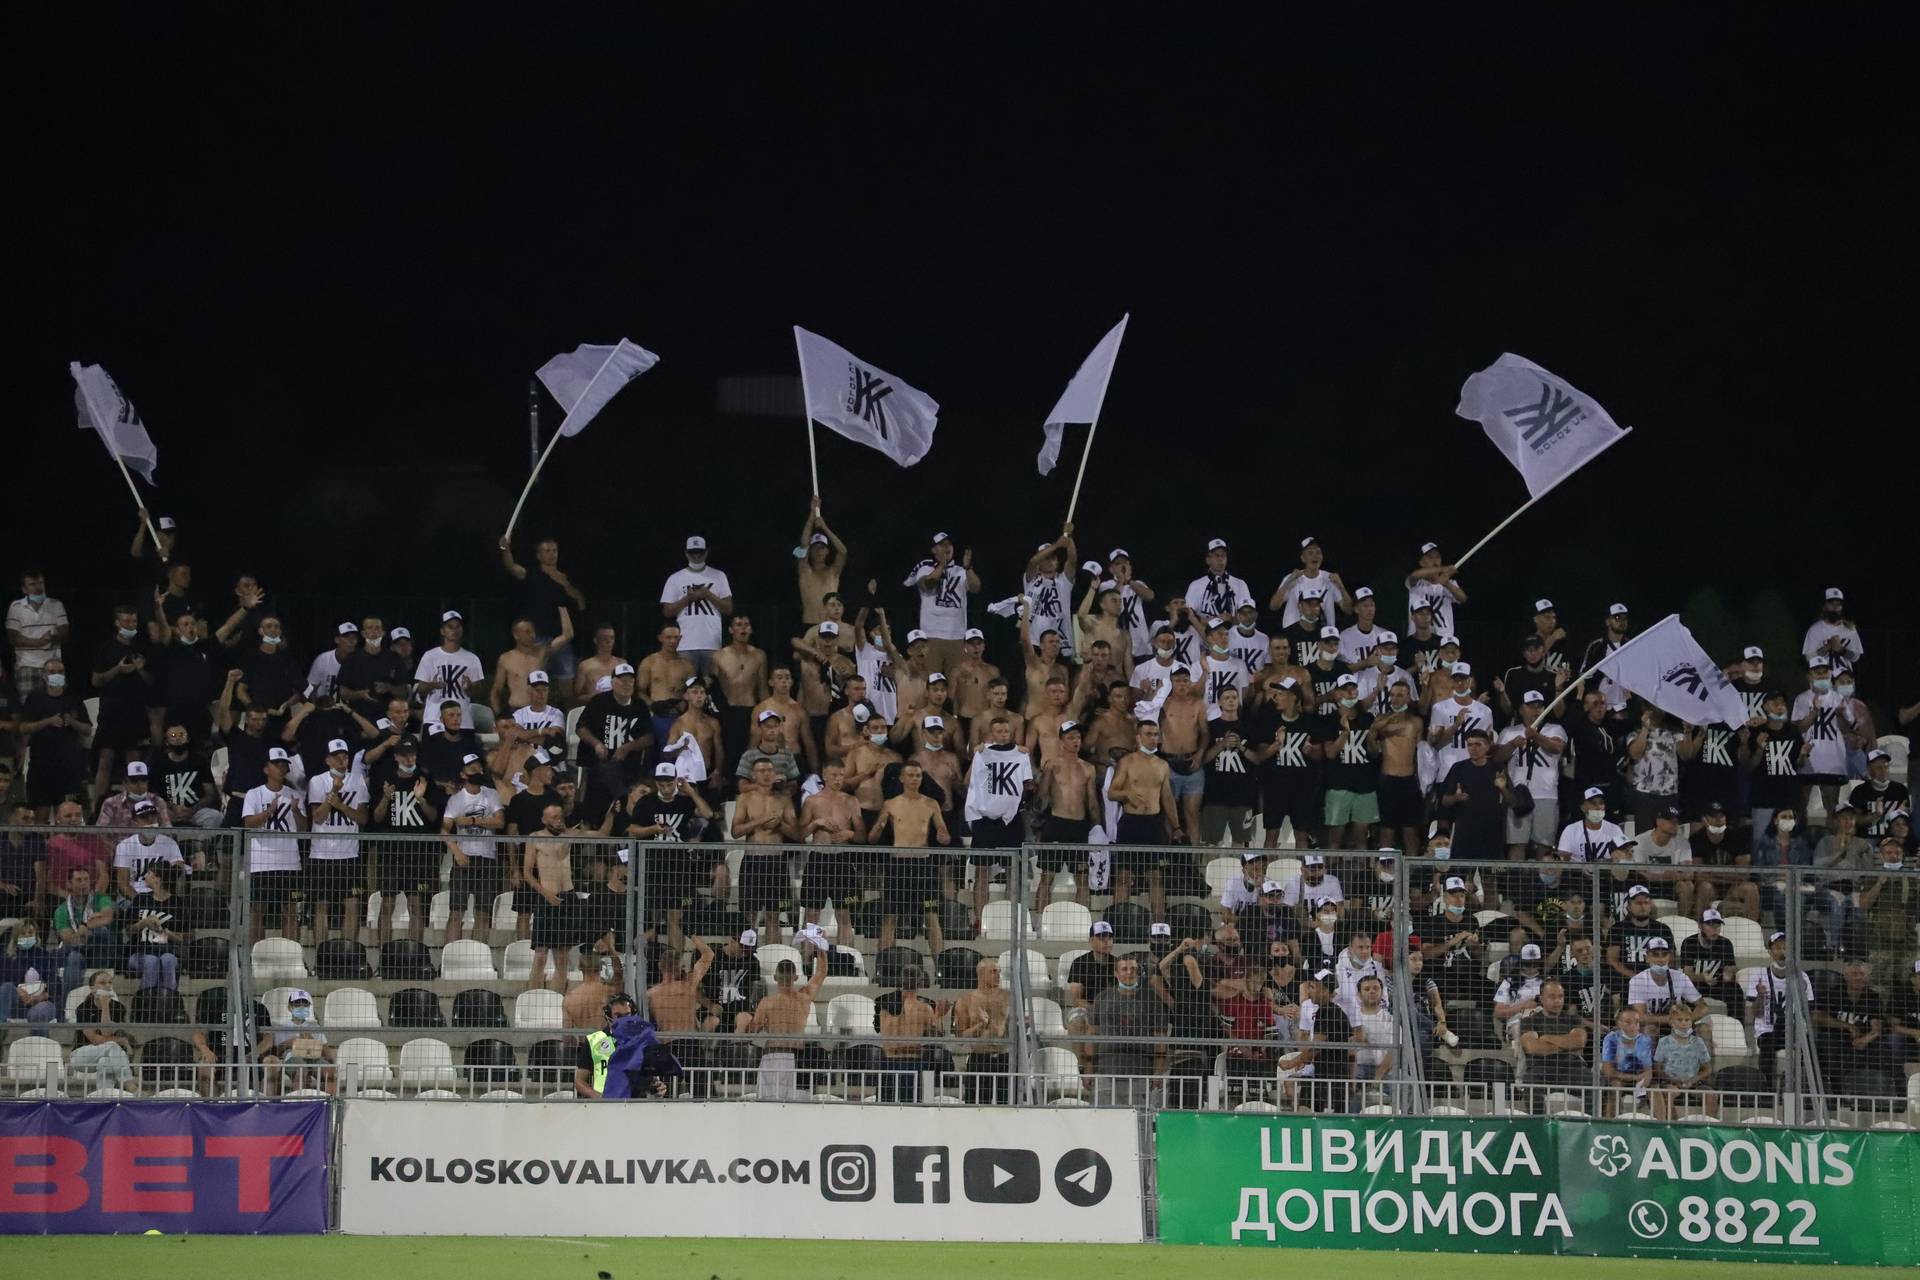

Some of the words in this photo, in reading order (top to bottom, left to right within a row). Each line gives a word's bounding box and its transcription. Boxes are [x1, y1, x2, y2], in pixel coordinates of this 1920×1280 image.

[0, 1135, 304, 1213] BET
[370, 1156, 810, 1185] KOLOSKOVALIVKA.COM
[1261, 1128, 1542, 1181] ШВИДКА
[1638, 1137, 1854, 1185] ADONIS
[1231, 1188, 1574, 1241] ДОПОМОГА
[1678, 1195, 1820, 1245] 8822
